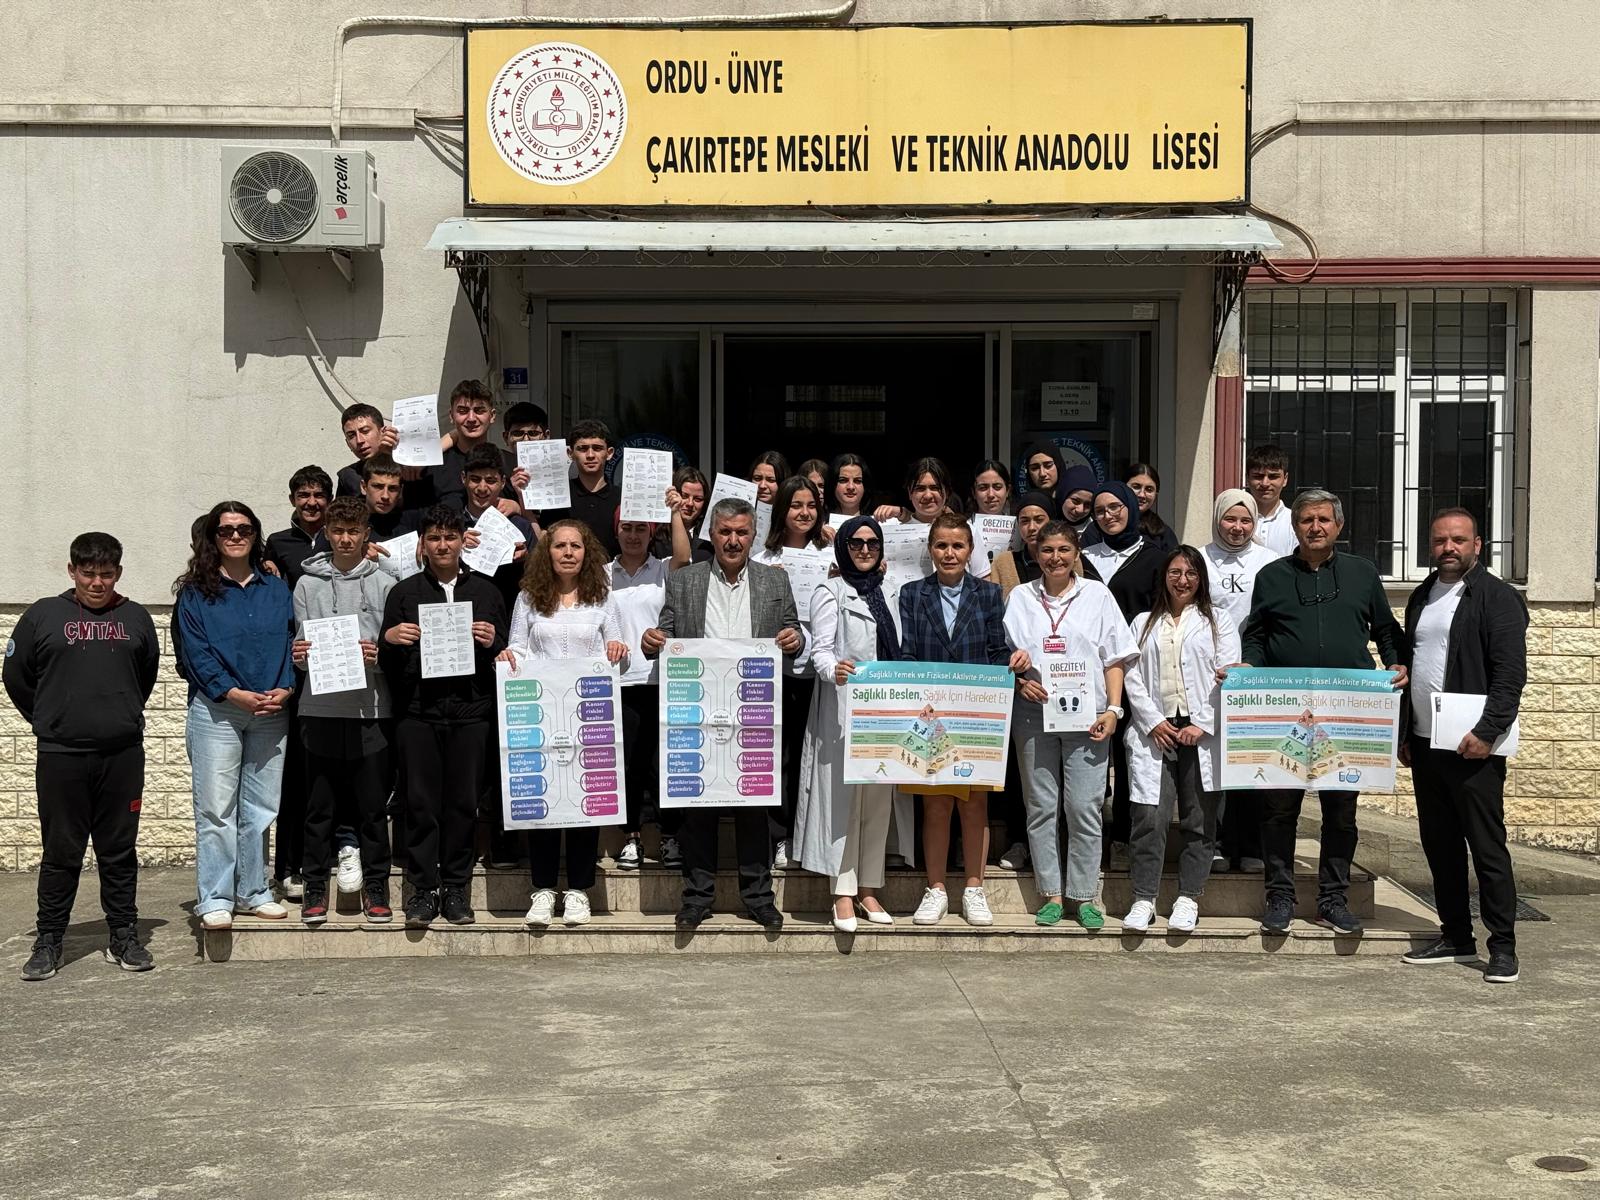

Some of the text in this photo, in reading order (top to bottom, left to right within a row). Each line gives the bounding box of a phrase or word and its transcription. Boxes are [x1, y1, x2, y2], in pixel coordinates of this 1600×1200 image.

[646, 60, 706, 95] ORDU
[728, 51, 783, 95] ÜNYE
[515, 73, 552, 123] CUMHURİYETİ
[579, 81, 599, 110] EĞİTİM
[517, 123, 549, 155] TÜRKİYE
[568, 112, 600, 155] BAKANLIĞI
[646, 122, 1219, 184] ÇAKIRTEPE MESLEKİ VE TEKNİK ANADOLU LİSESİ
[334, 155, 351, 205] arçelik
[510, 373, 521, 384] 31
[1062, 437, 1094, 458] TEKNİK
[64, 621, 130, 645] ÇMTAL
[868, 670, 892, 680] Sağlıklı
[893, 672, 915, 680] Yemek
[926, 672, 950, 681] Fiziksel
[952, 673, 978, 682] Aktivite
[979, 674, 1006, 683] Piramidi
[1050, 660, 1086, 672] OBEZİTEYİ
[1243, 676, 1269, 685] Sağlıklı
[1270, 677, 1293, 685] Yemek
[1304, 677, 1331, 686] Fiziksel
[1332, 678, 1360, 686] Aktivite
[852, 687, 1008, 705] Sağlıklı Beslen, Sağlık İçin Hareket Et
[1226, 694, 1393, 710] Sağlıklı Beslen, Sağlık İçin Hareket Et
